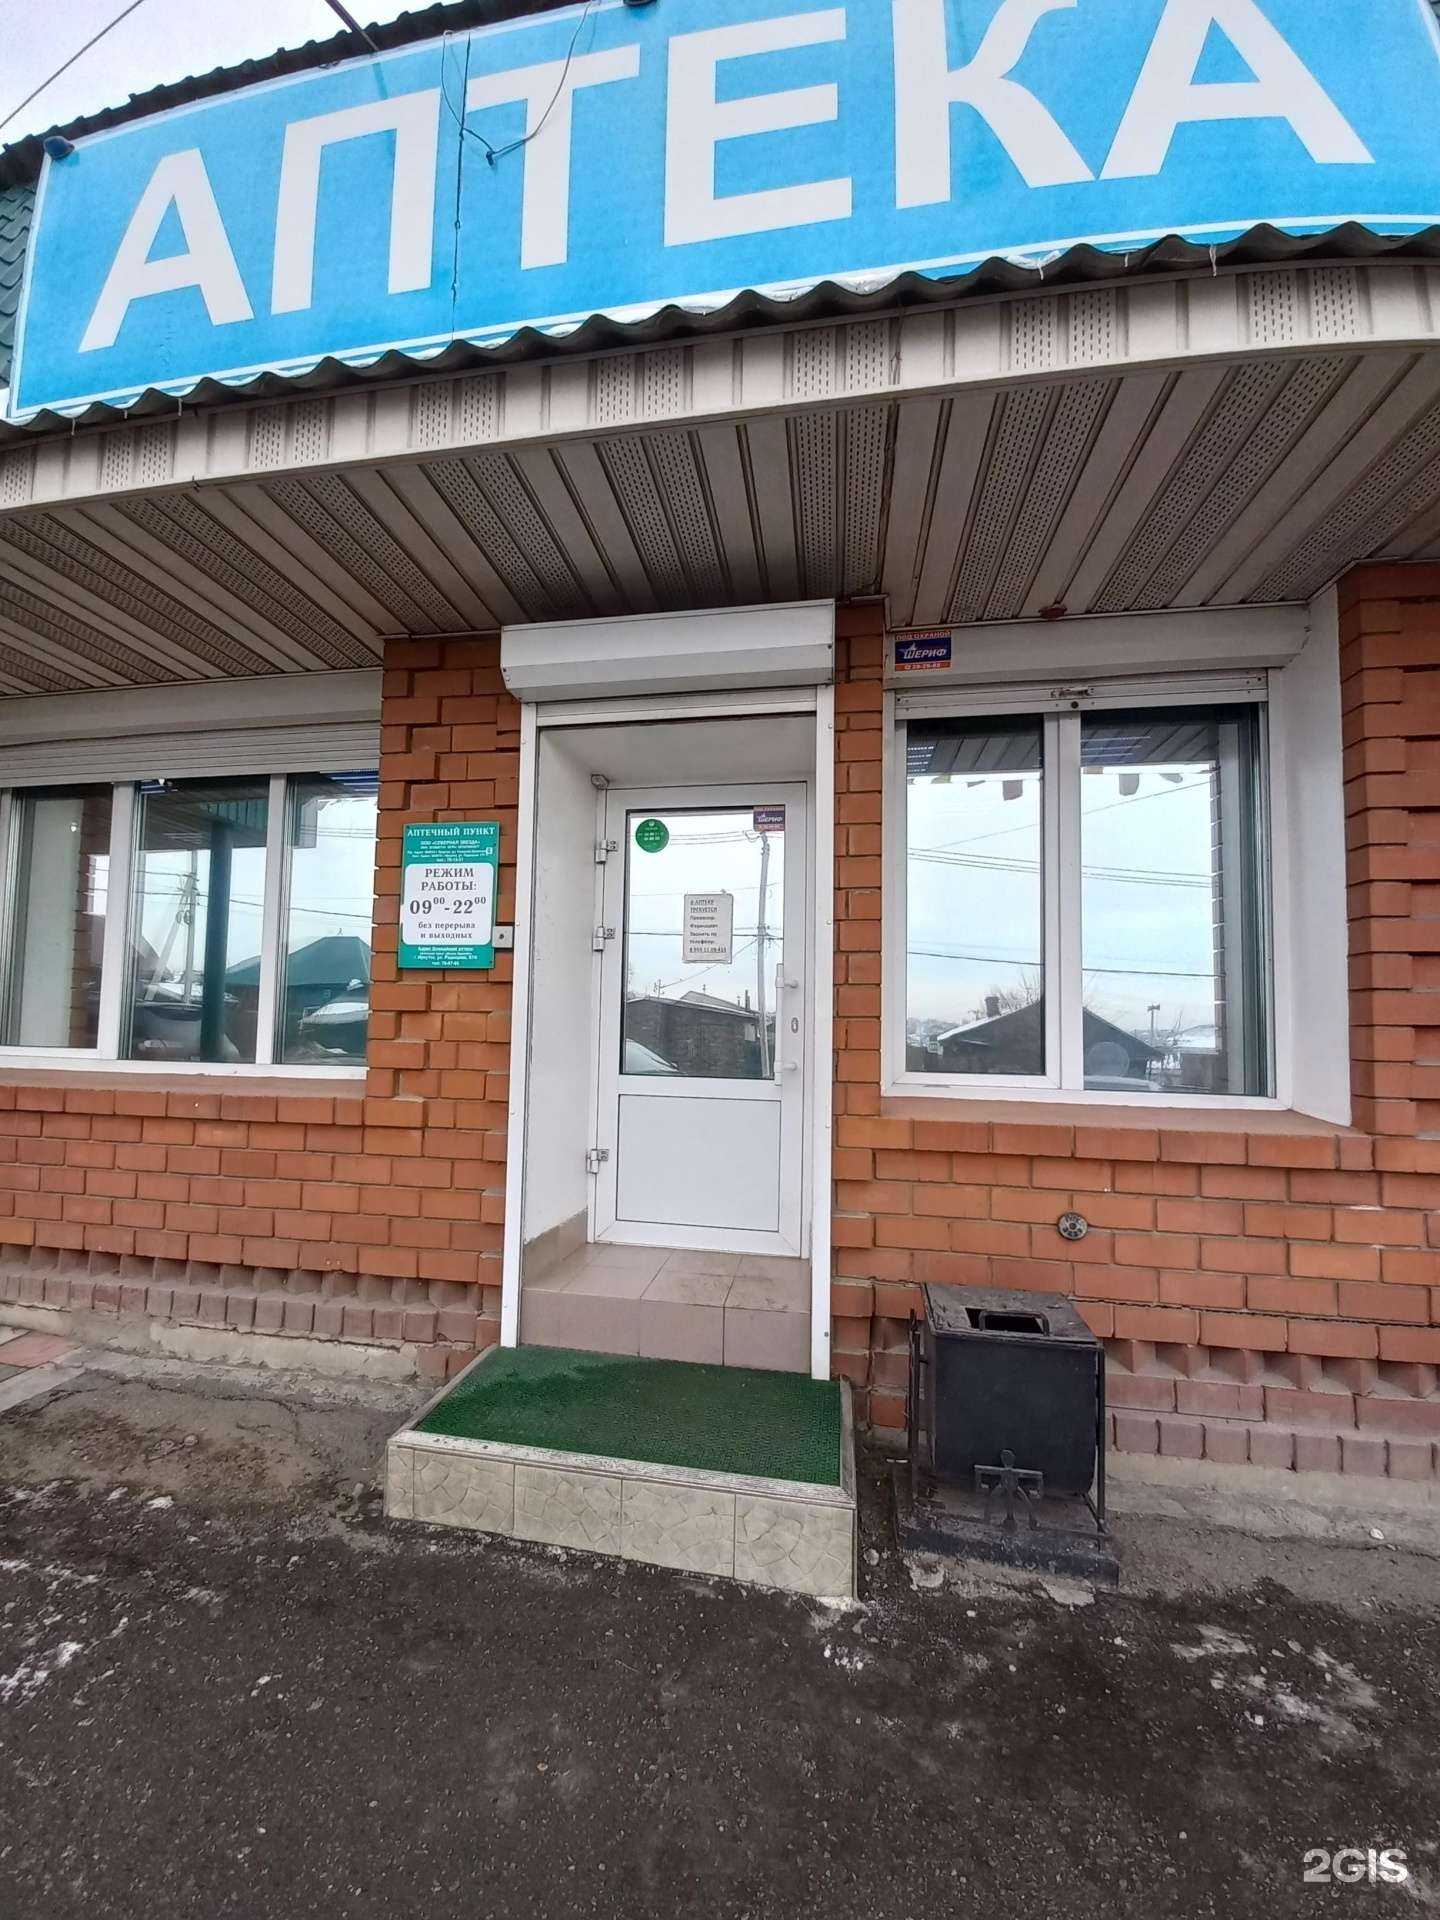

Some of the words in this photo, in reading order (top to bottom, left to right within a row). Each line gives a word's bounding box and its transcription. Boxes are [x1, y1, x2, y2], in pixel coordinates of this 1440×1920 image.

[78, 0, 1375, 352] АПТЕКА
[903, 647, 947, 659] ШЕРИФ
[407, 827, 460, 836] АПТЕЧНЫЙ
[463, 827, 496, 836] ПУНКТ
[425, 868, 474, 878] РЕЖИМ
[421, 881, 477, 891] РАБОТЫ:
[435, 922, 476, 931] перерыва
[429, 932, 473, 940] выходных
